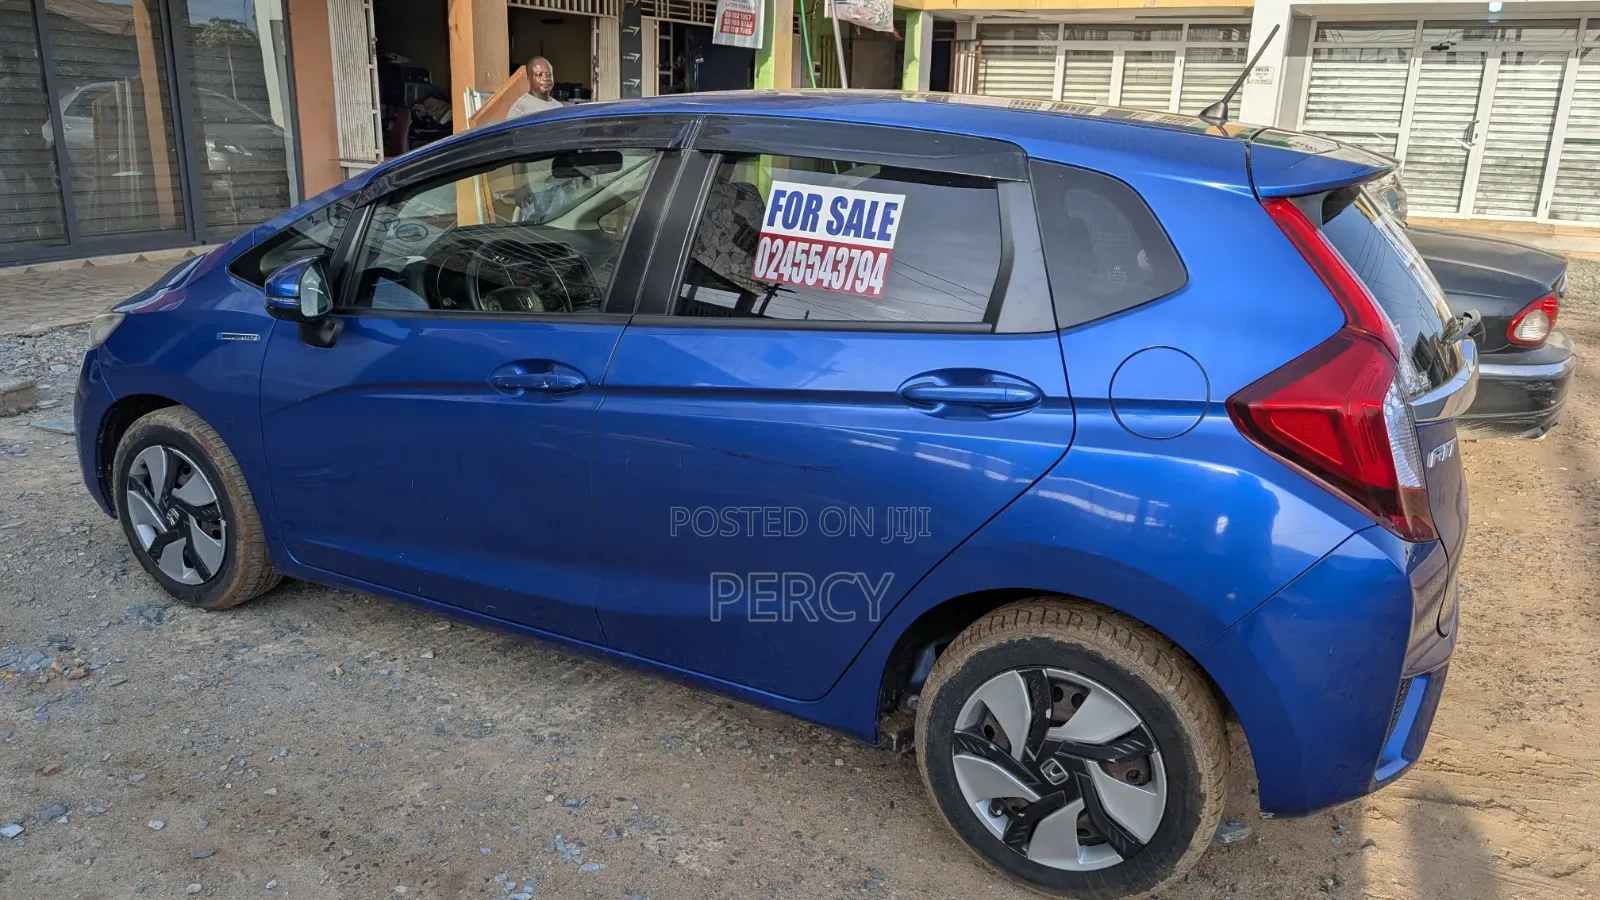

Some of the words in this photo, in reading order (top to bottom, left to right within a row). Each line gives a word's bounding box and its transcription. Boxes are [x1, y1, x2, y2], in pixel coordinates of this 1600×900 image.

[766, 189, 823, 232] FOR
[825, 195, 898, 241] SALE
[754, 236, 888, 295] 0245543794
